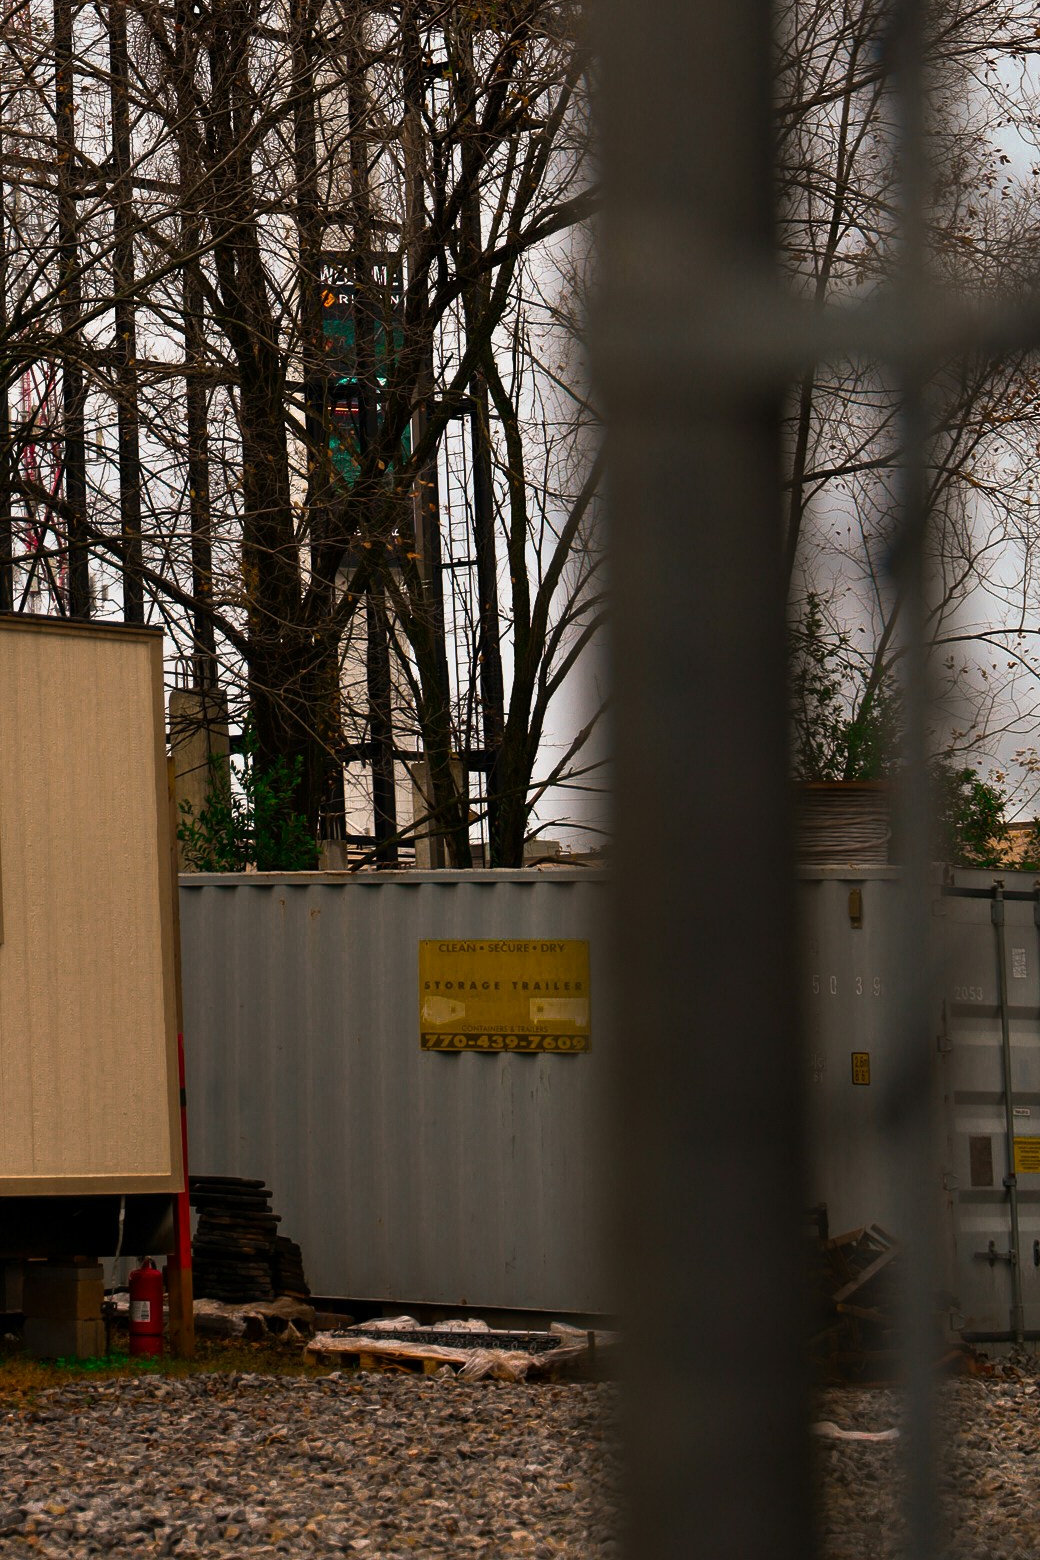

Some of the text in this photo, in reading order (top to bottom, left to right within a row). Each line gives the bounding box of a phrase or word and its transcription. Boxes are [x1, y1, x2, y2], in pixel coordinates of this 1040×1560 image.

[438, 943, 566, 953] CLEAN SECURE DRY
[424, 981, 583, 991] STORAGE TRAILER
[461, 1024, 508, 1033] CONTAINERS
[425, 1034, 585, 1049] 770-439-7609
